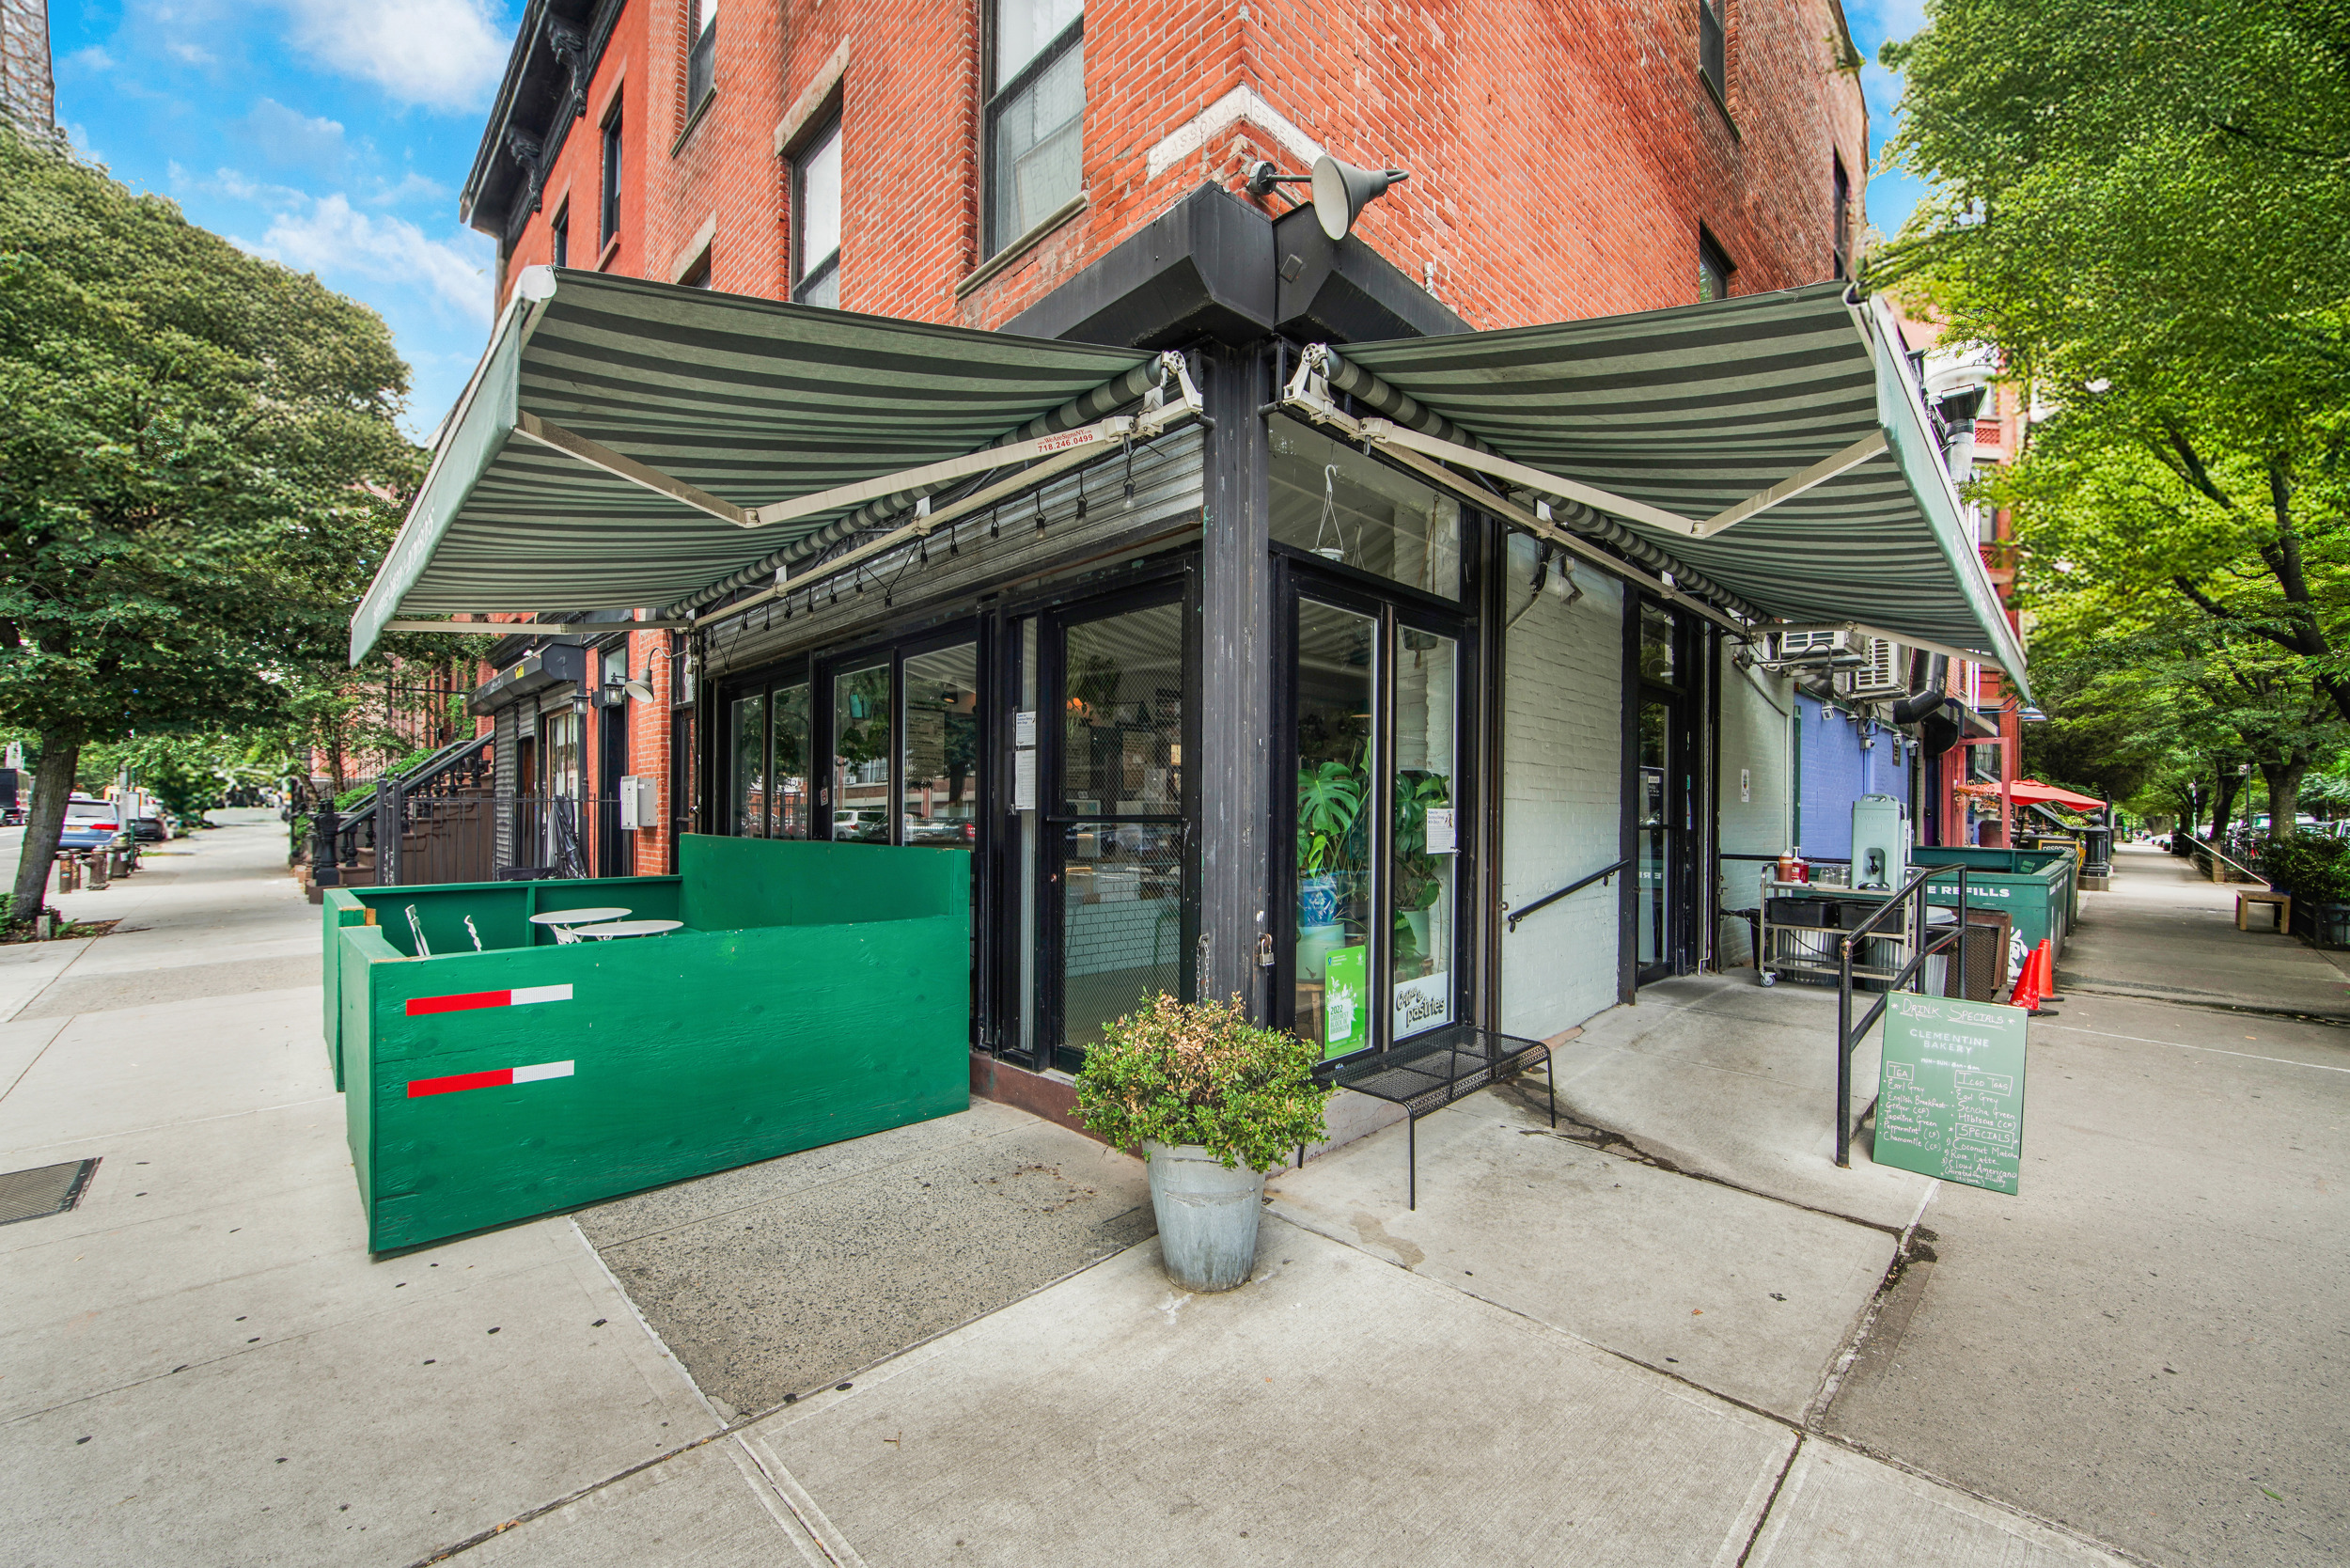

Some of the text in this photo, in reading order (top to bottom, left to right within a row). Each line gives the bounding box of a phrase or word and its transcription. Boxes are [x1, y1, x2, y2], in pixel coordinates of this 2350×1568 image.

[1038, 433, 1093, 453] 718.246.0499
[1941, 886, 2010, 898] REFILLS
[1330, 1004, 1343, 1015] 2022
[1406, 996, 1446, 1028] pastries
[1909, 1028, 1990, 1048] CLEMENTINE
[1923, 1040, 1973, 1055] BAKERY
[1888, 1064, 1908, 1078] TEA
[1888, 1078, 1924, 1097] Earl Grey
[1888, 1090, 1913, 1106] English
[1956, 1089, 1999, 1107] Earl Grey
[1957, 1100, 2015, 1120] Sencha Green
[1883, 1120, 1919, 1135] Peppermint
[1884, 1109, 1937, 1132] Jasmine Green
[1958, 1113, 1994, 1126] Hibiscus
[1883, 1131, 1922, 1147] Chamomile
[1959, 1125, 2010, 1143] SPECIALS
[1952, 1138, 1988, 1154] Coconut
[1992, 1147, 2020, 1159] Matcha
[1974, 1153, 2000, 1166] Latte
[1949, 1159, 1972, 1170] Cloud
[1976, 1163, 2017, 1179] Americano
